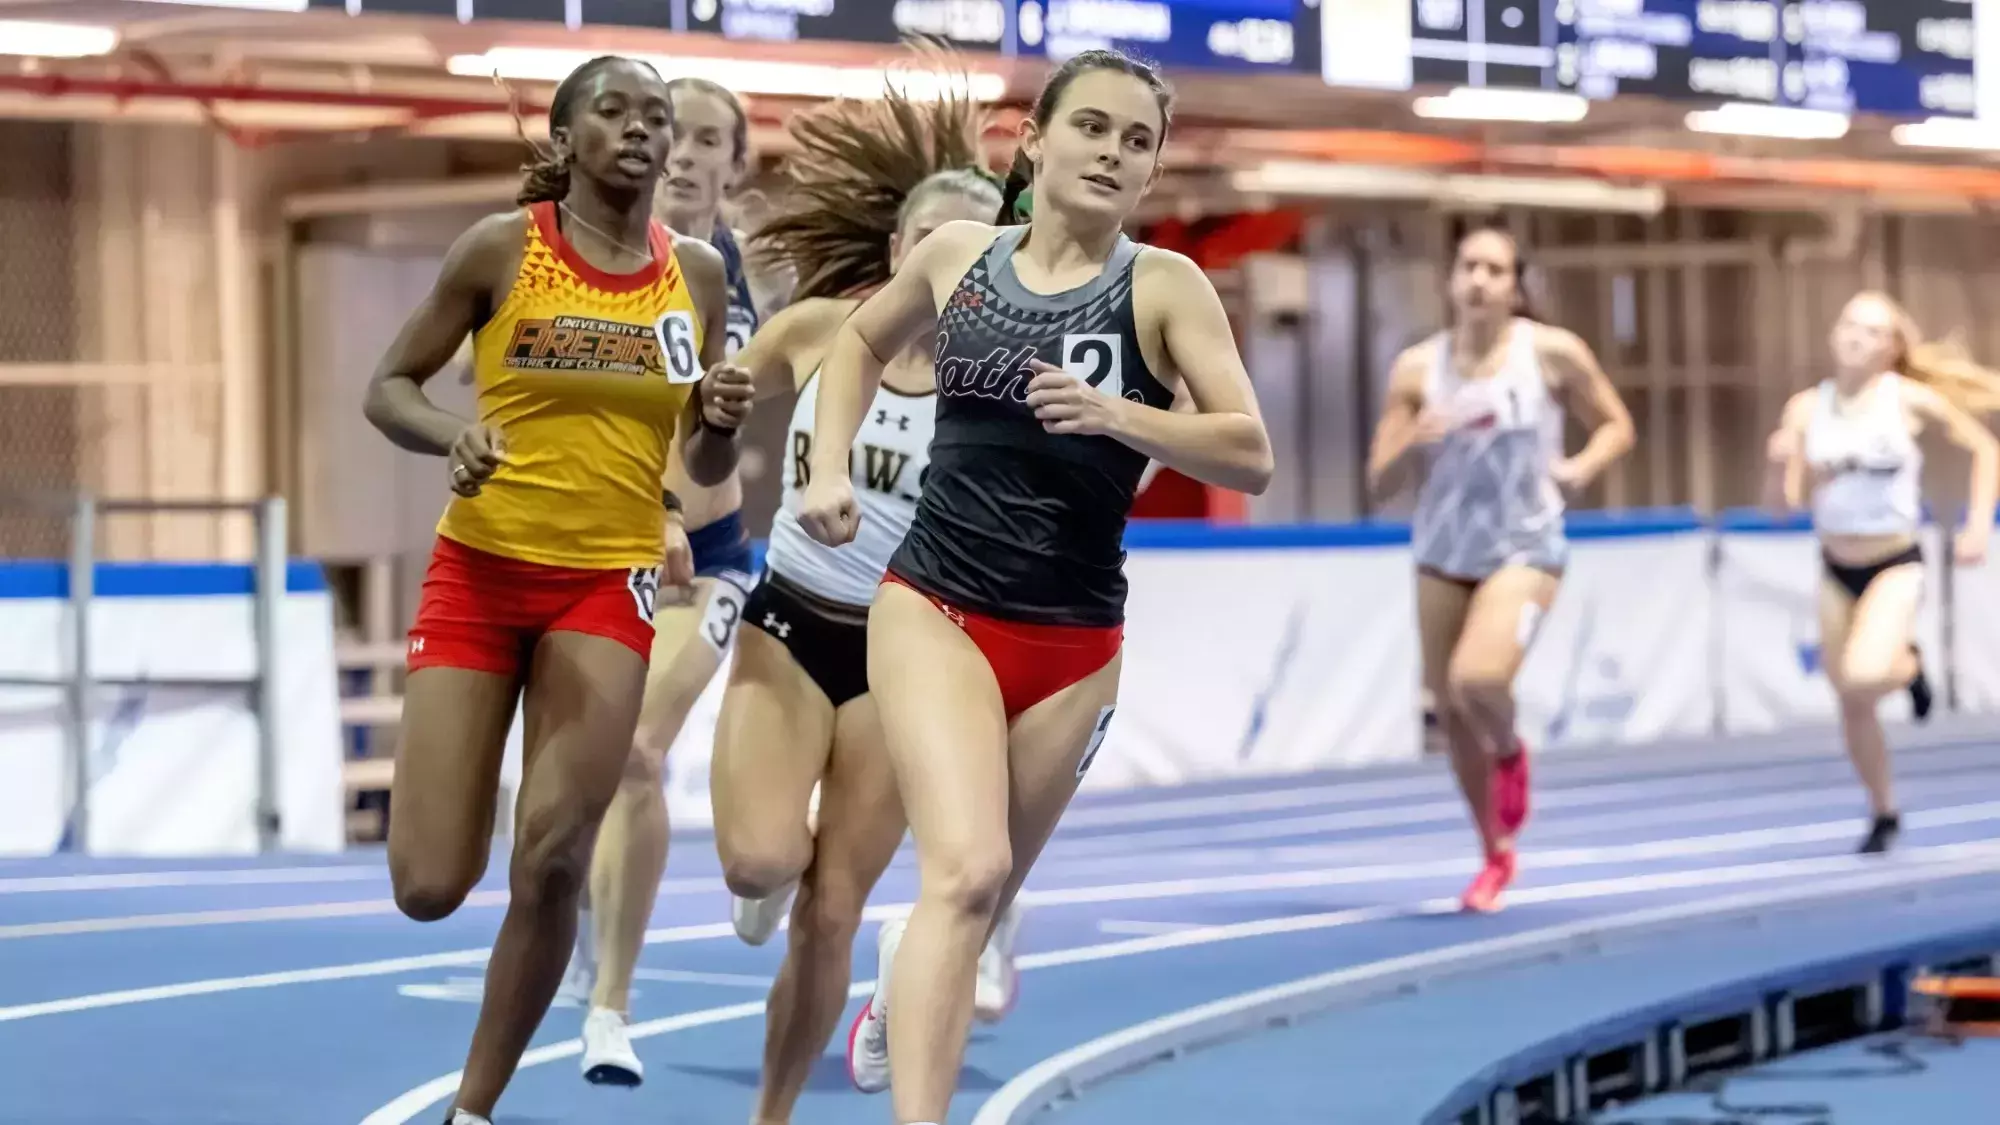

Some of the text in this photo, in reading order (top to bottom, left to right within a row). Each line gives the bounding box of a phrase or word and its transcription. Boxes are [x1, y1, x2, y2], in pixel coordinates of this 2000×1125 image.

[555, 316, 640, 337] UNIVERSITY
[662, 315, 694, 378] 6
[559, 358, 575, 370] OF
[1070, 339, 1113, 388] 2
[708, 596, 738, 650] 3
